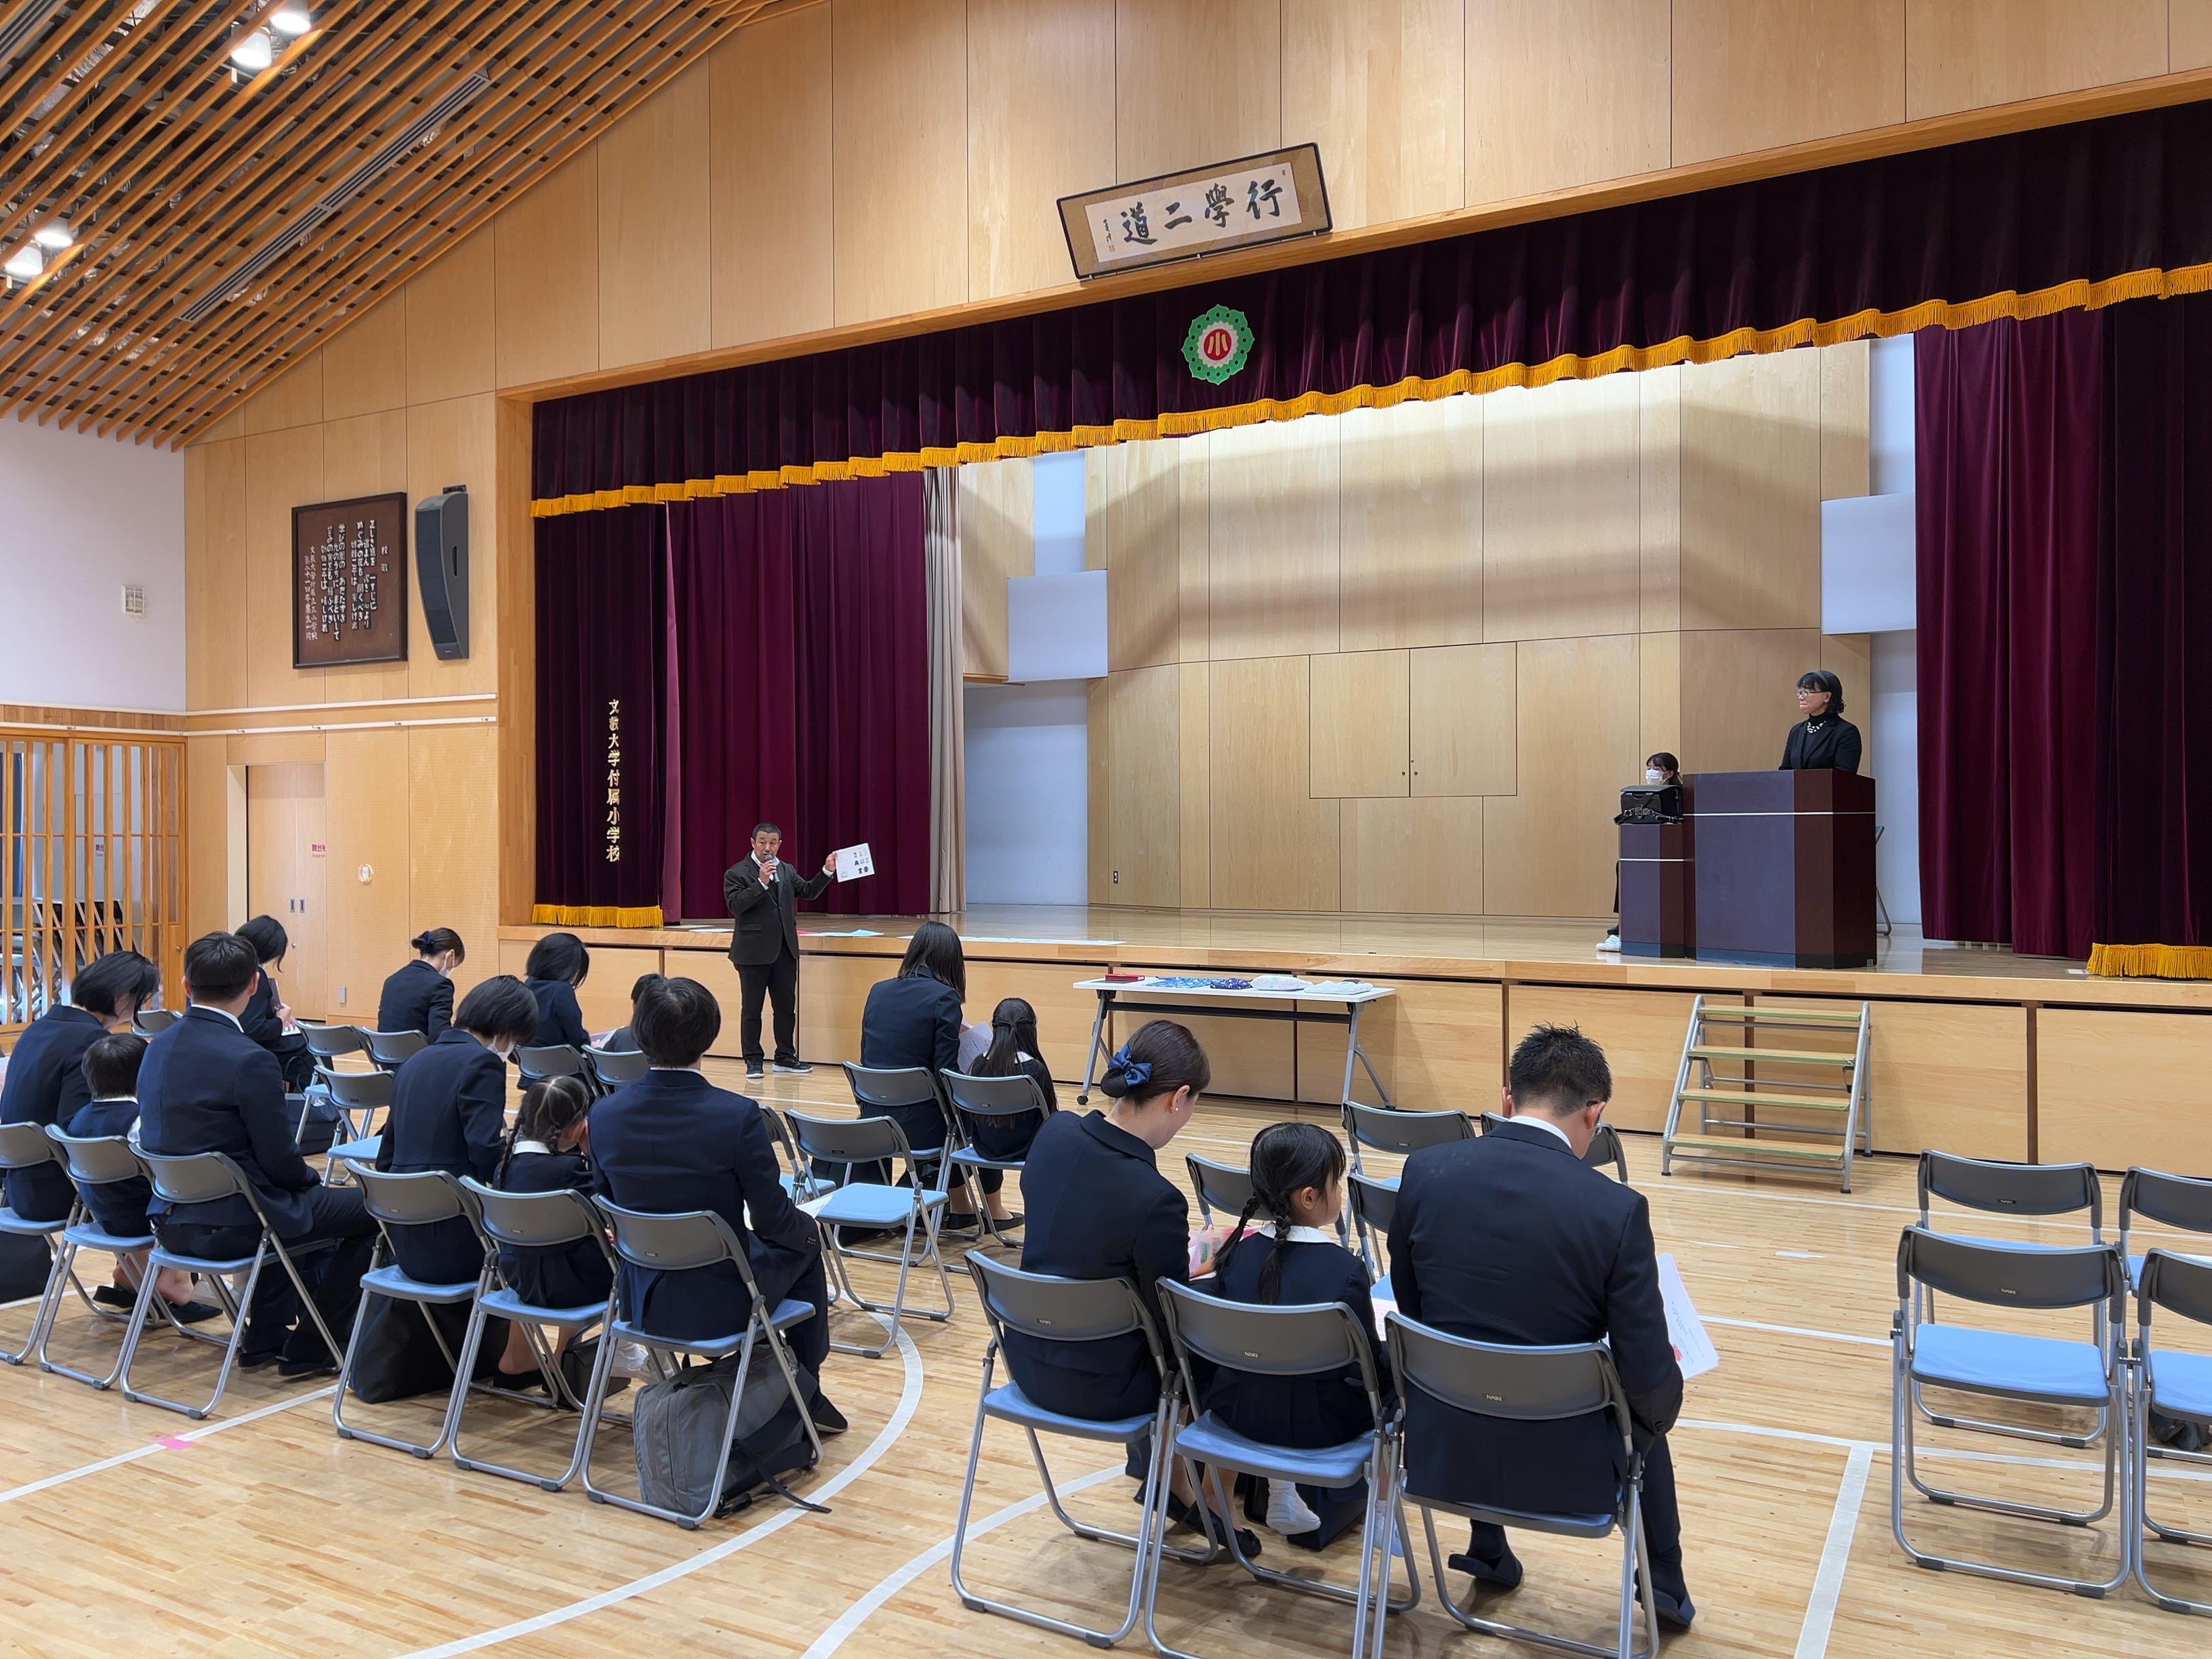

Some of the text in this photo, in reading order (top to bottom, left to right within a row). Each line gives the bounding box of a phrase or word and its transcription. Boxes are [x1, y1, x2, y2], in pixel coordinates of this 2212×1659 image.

[1207, 331, 1228, 356] 小
[606, 699, 621, 863] 文教大学付属小学校
[1486, 1393, 1502, 1401] NAIKI
